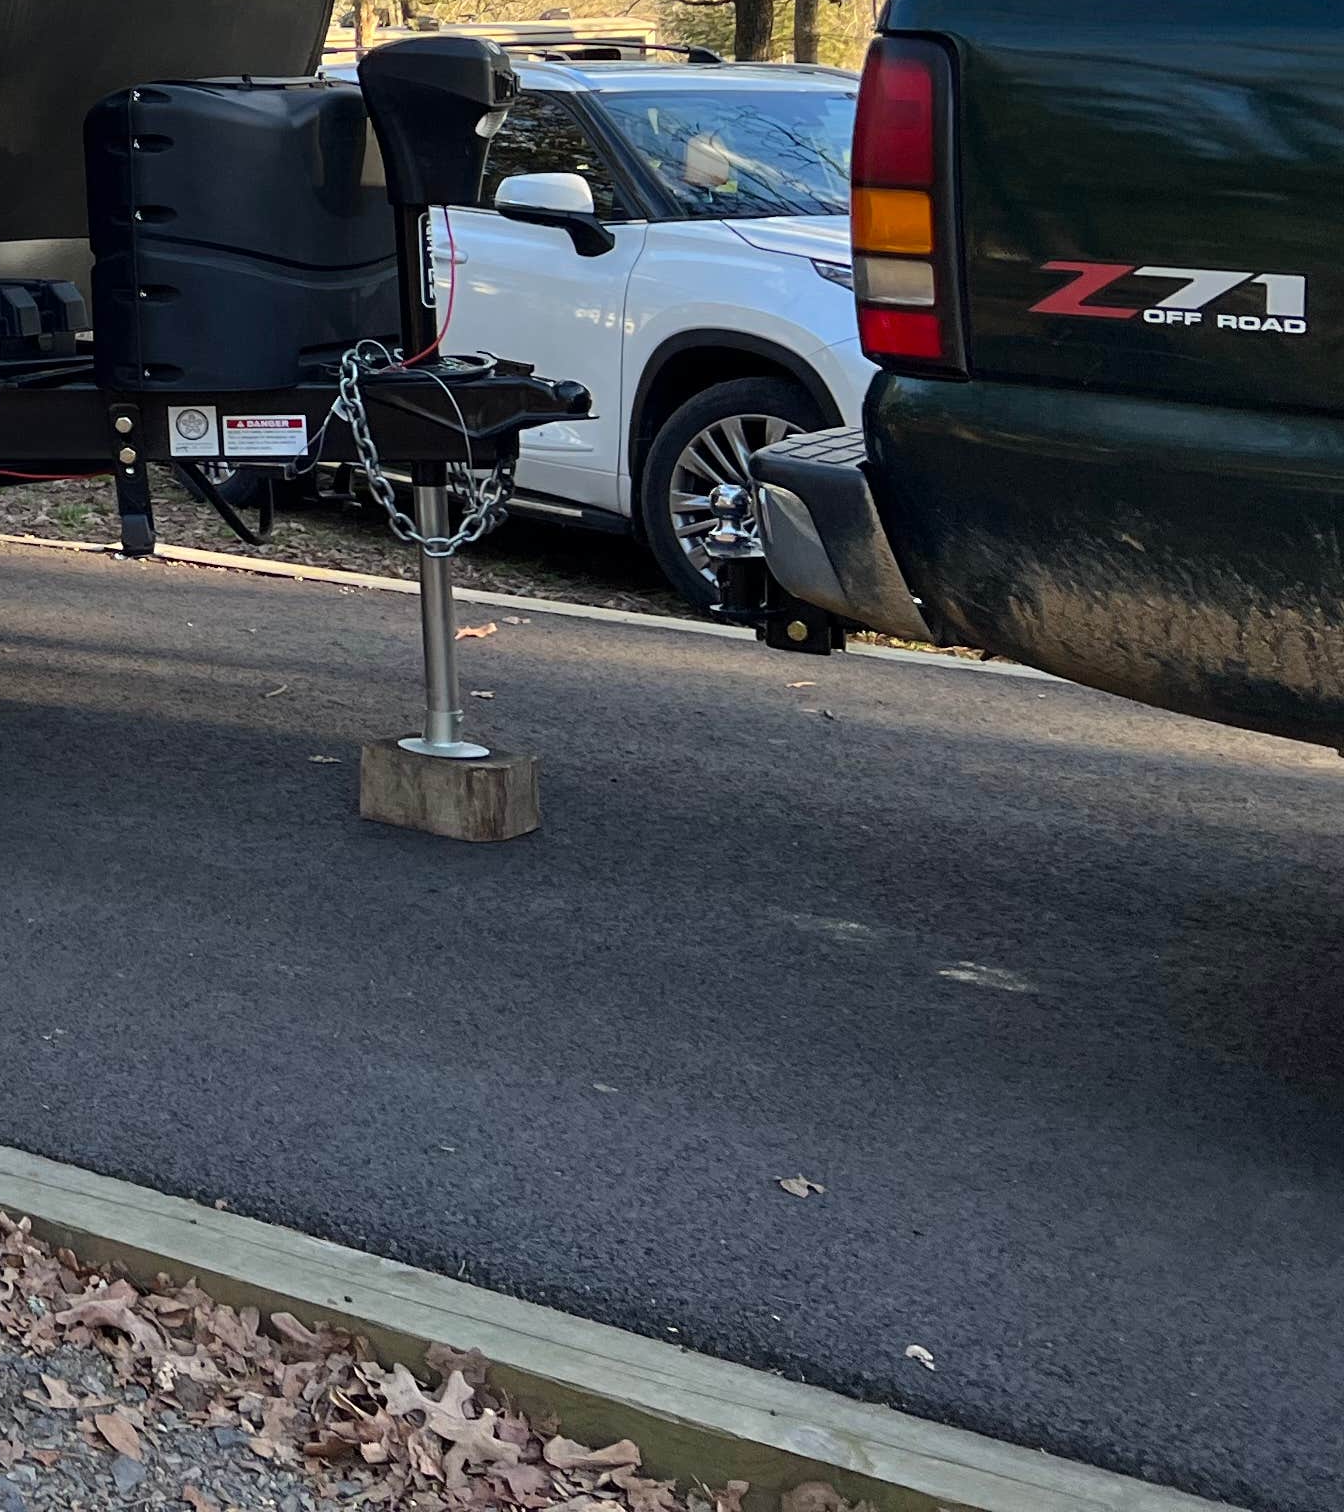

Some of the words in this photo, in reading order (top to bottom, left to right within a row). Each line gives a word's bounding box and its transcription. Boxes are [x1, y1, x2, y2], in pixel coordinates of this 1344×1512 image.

[1027, 260, 1307, 320] Z71
[1143, 308, 1202, 326] OFF
[1217, 313, 1307, 335] ROAD
[246, 419, 290, 428] DANGER
